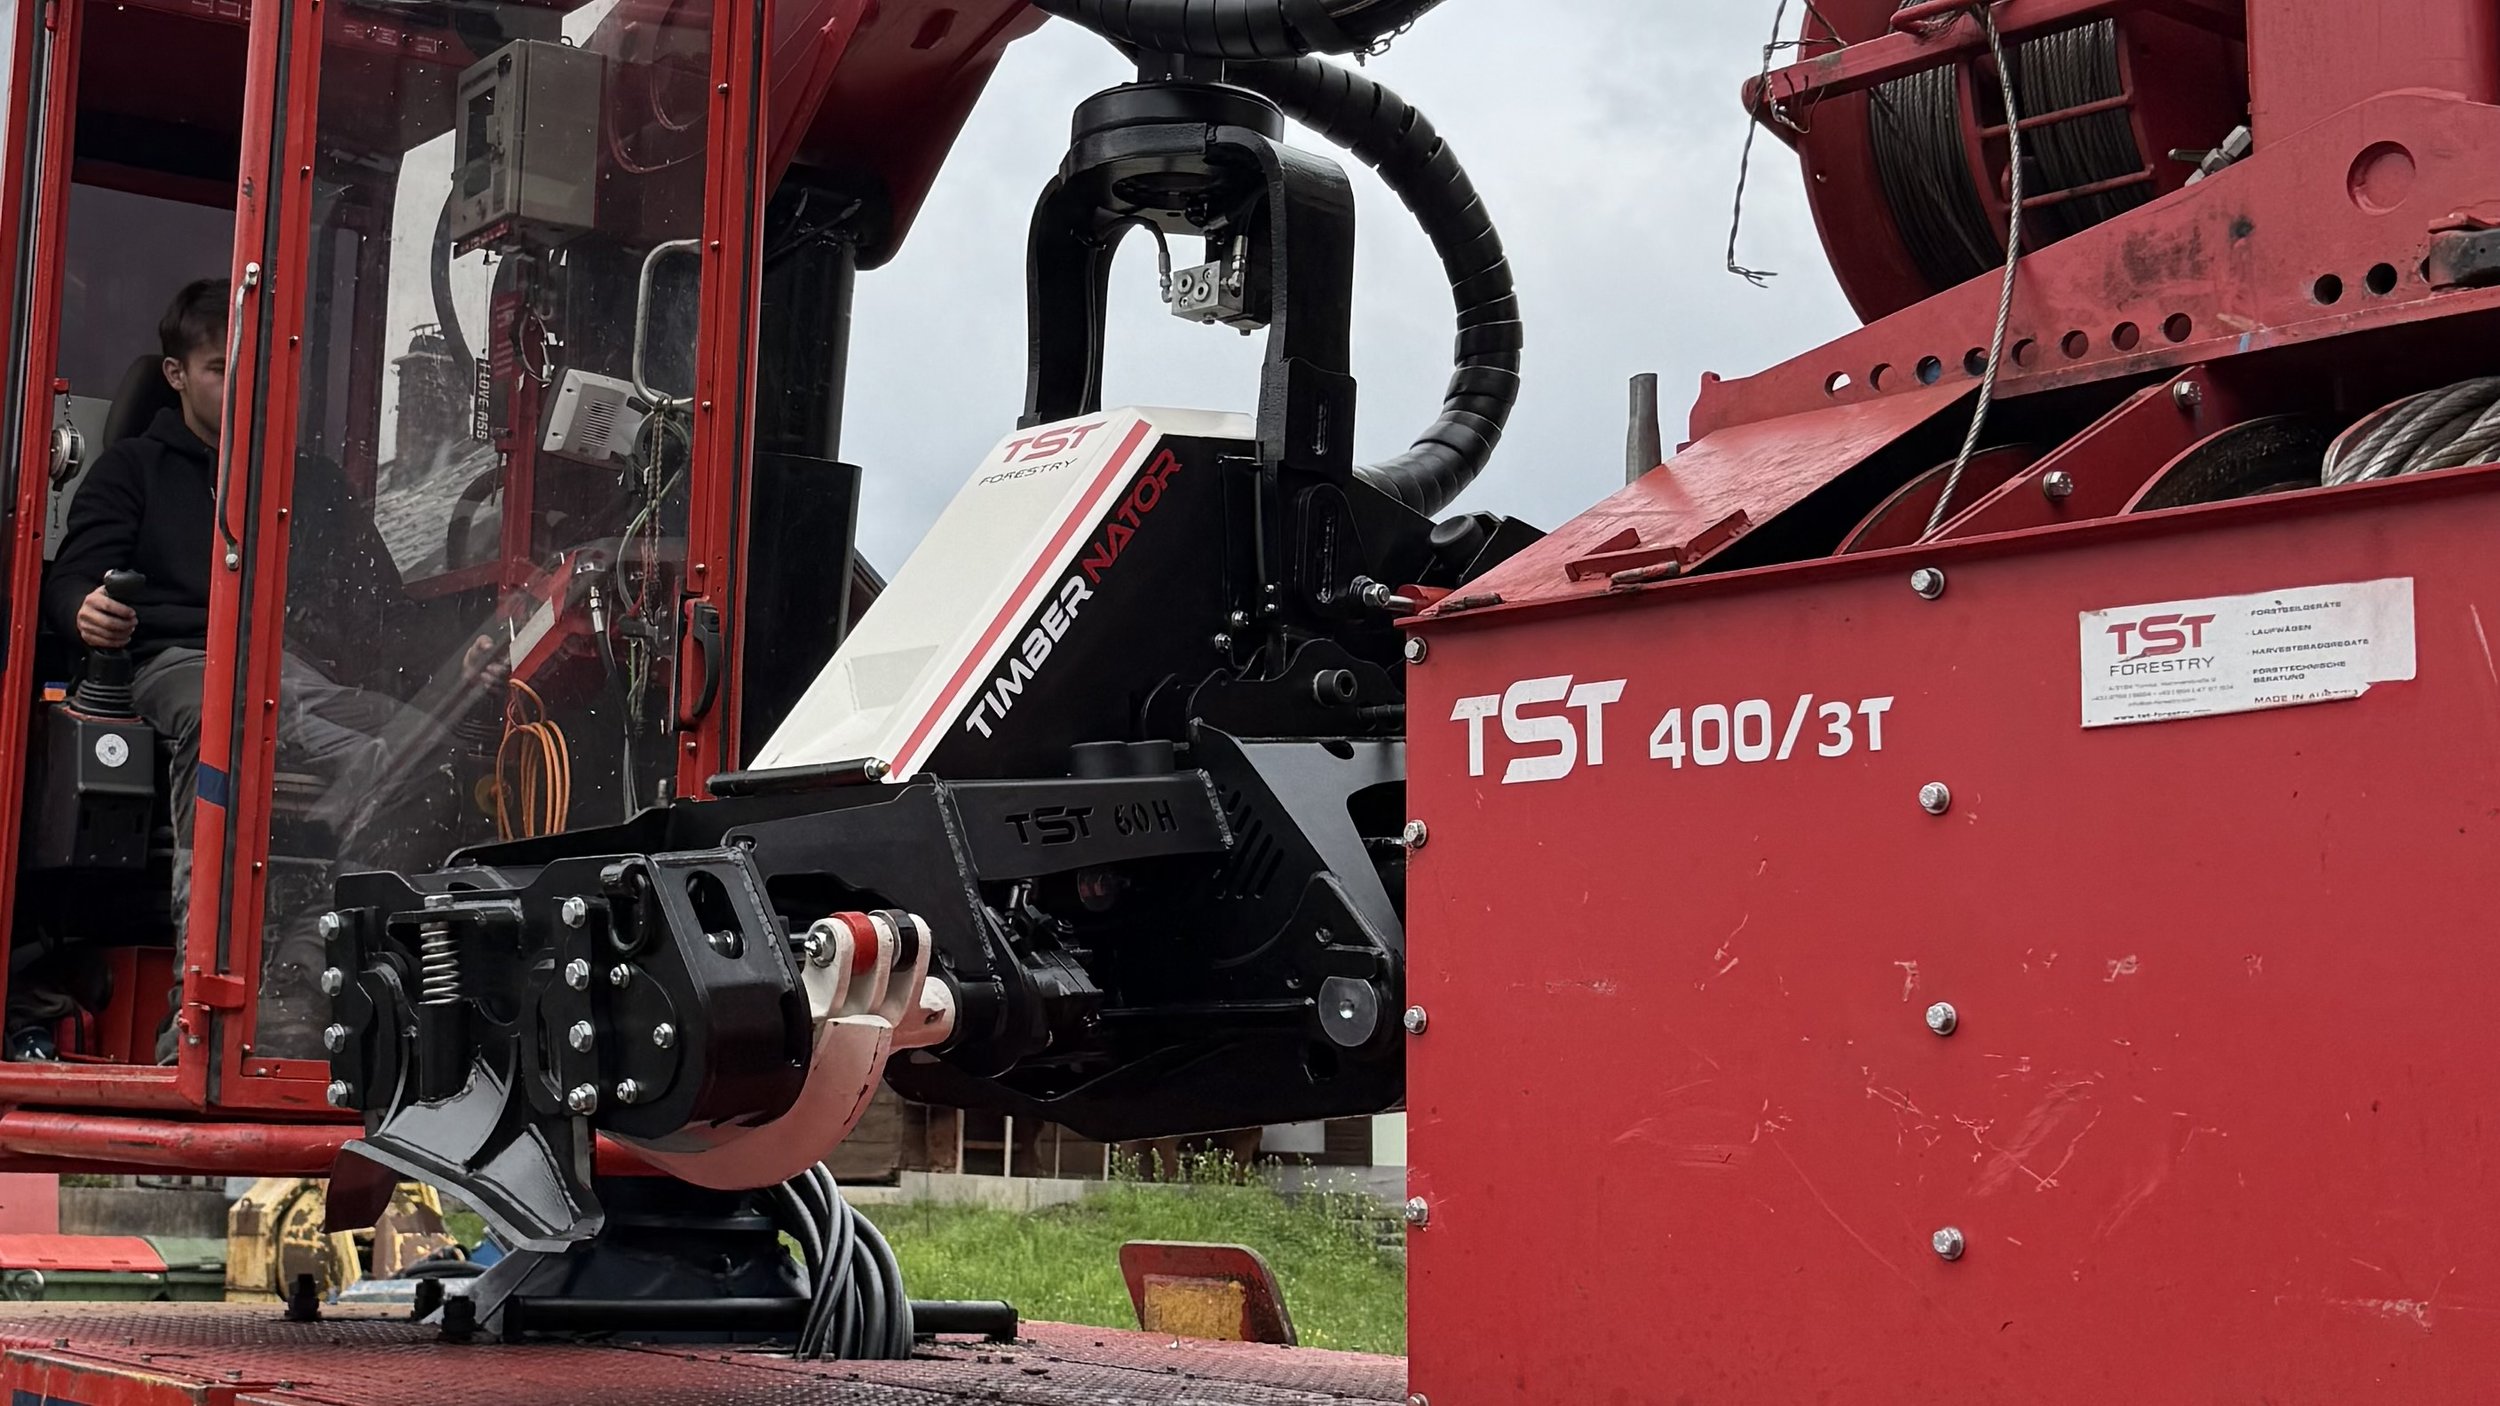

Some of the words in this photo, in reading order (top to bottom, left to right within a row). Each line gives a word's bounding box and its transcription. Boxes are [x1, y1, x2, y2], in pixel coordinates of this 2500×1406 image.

[478, 371, 490, 408] LOVE
[476, 410, 489, 440] ASS
[1003, 421, 1108, 463] TST
[978, 457, 1078, 486] FORESTRY
[2105, 613, 2217, 658] TST
[2109, 656, 2216, 677] FORESTRY
[2254, 694, 2288, 703] MADE
[1450, 674, 1628, 785] TST
[1649, 693, 1895, 769] 400/3T
[1004, 805, 1094, 846] TST
